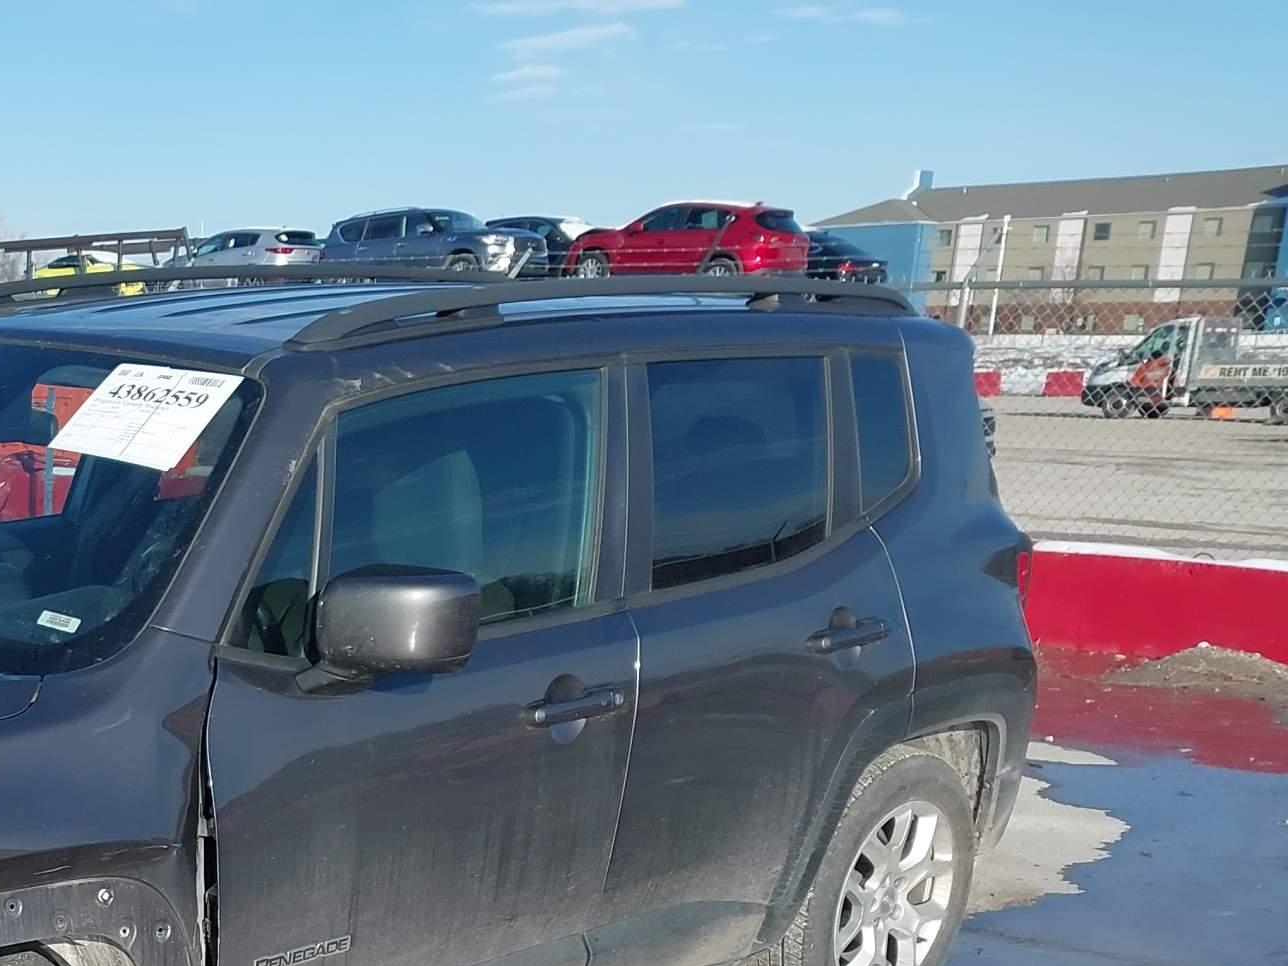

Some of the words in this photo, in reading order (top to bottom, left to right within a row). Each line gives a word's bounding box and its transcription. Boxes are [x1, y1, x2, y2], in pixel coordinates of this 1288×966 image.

[1219, 367, 1249, 377] RENT
[1252, 367, 1269, 377] ME
[109, 383, 209, 409] 43862559
